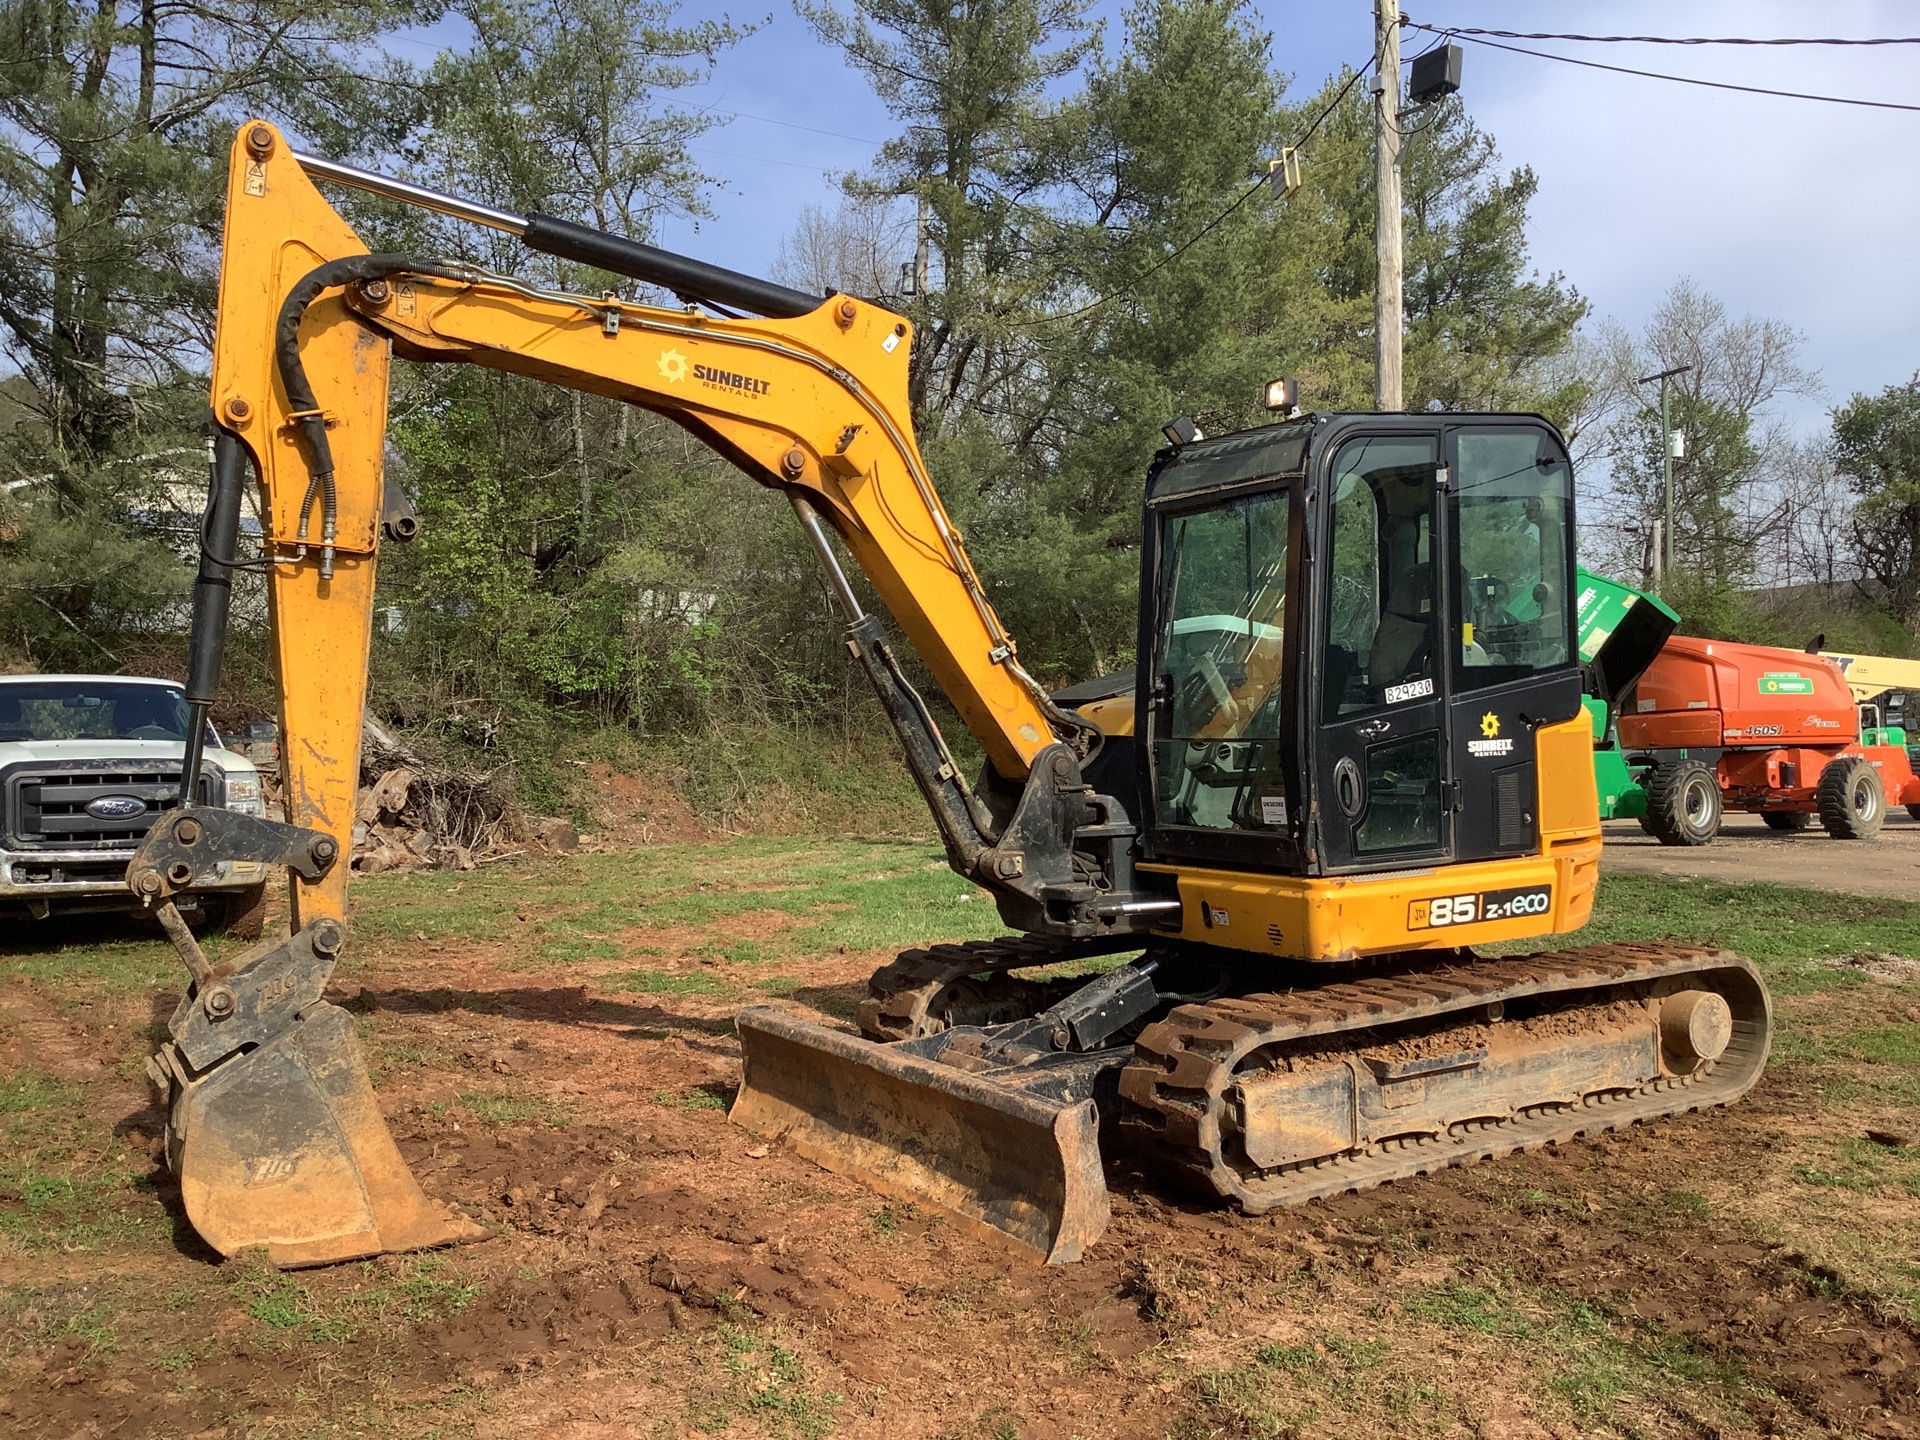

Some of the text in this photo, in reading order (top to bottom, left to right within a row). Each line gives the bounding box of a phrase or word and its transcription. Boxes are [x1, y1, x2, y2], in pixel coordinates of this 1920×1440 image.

[693, 364, 770, 395] SUNBELT
[703, 382, 758, 399] RENTALS
[1387, 680, 1432, 702] 829230
[1745, 724, 1784, 736] 460SJ
[1467, 739, 1513, 752] SUNBELT
[98, 800, 133, 813] Ford
[1430, 895, 1476, 926] 85
